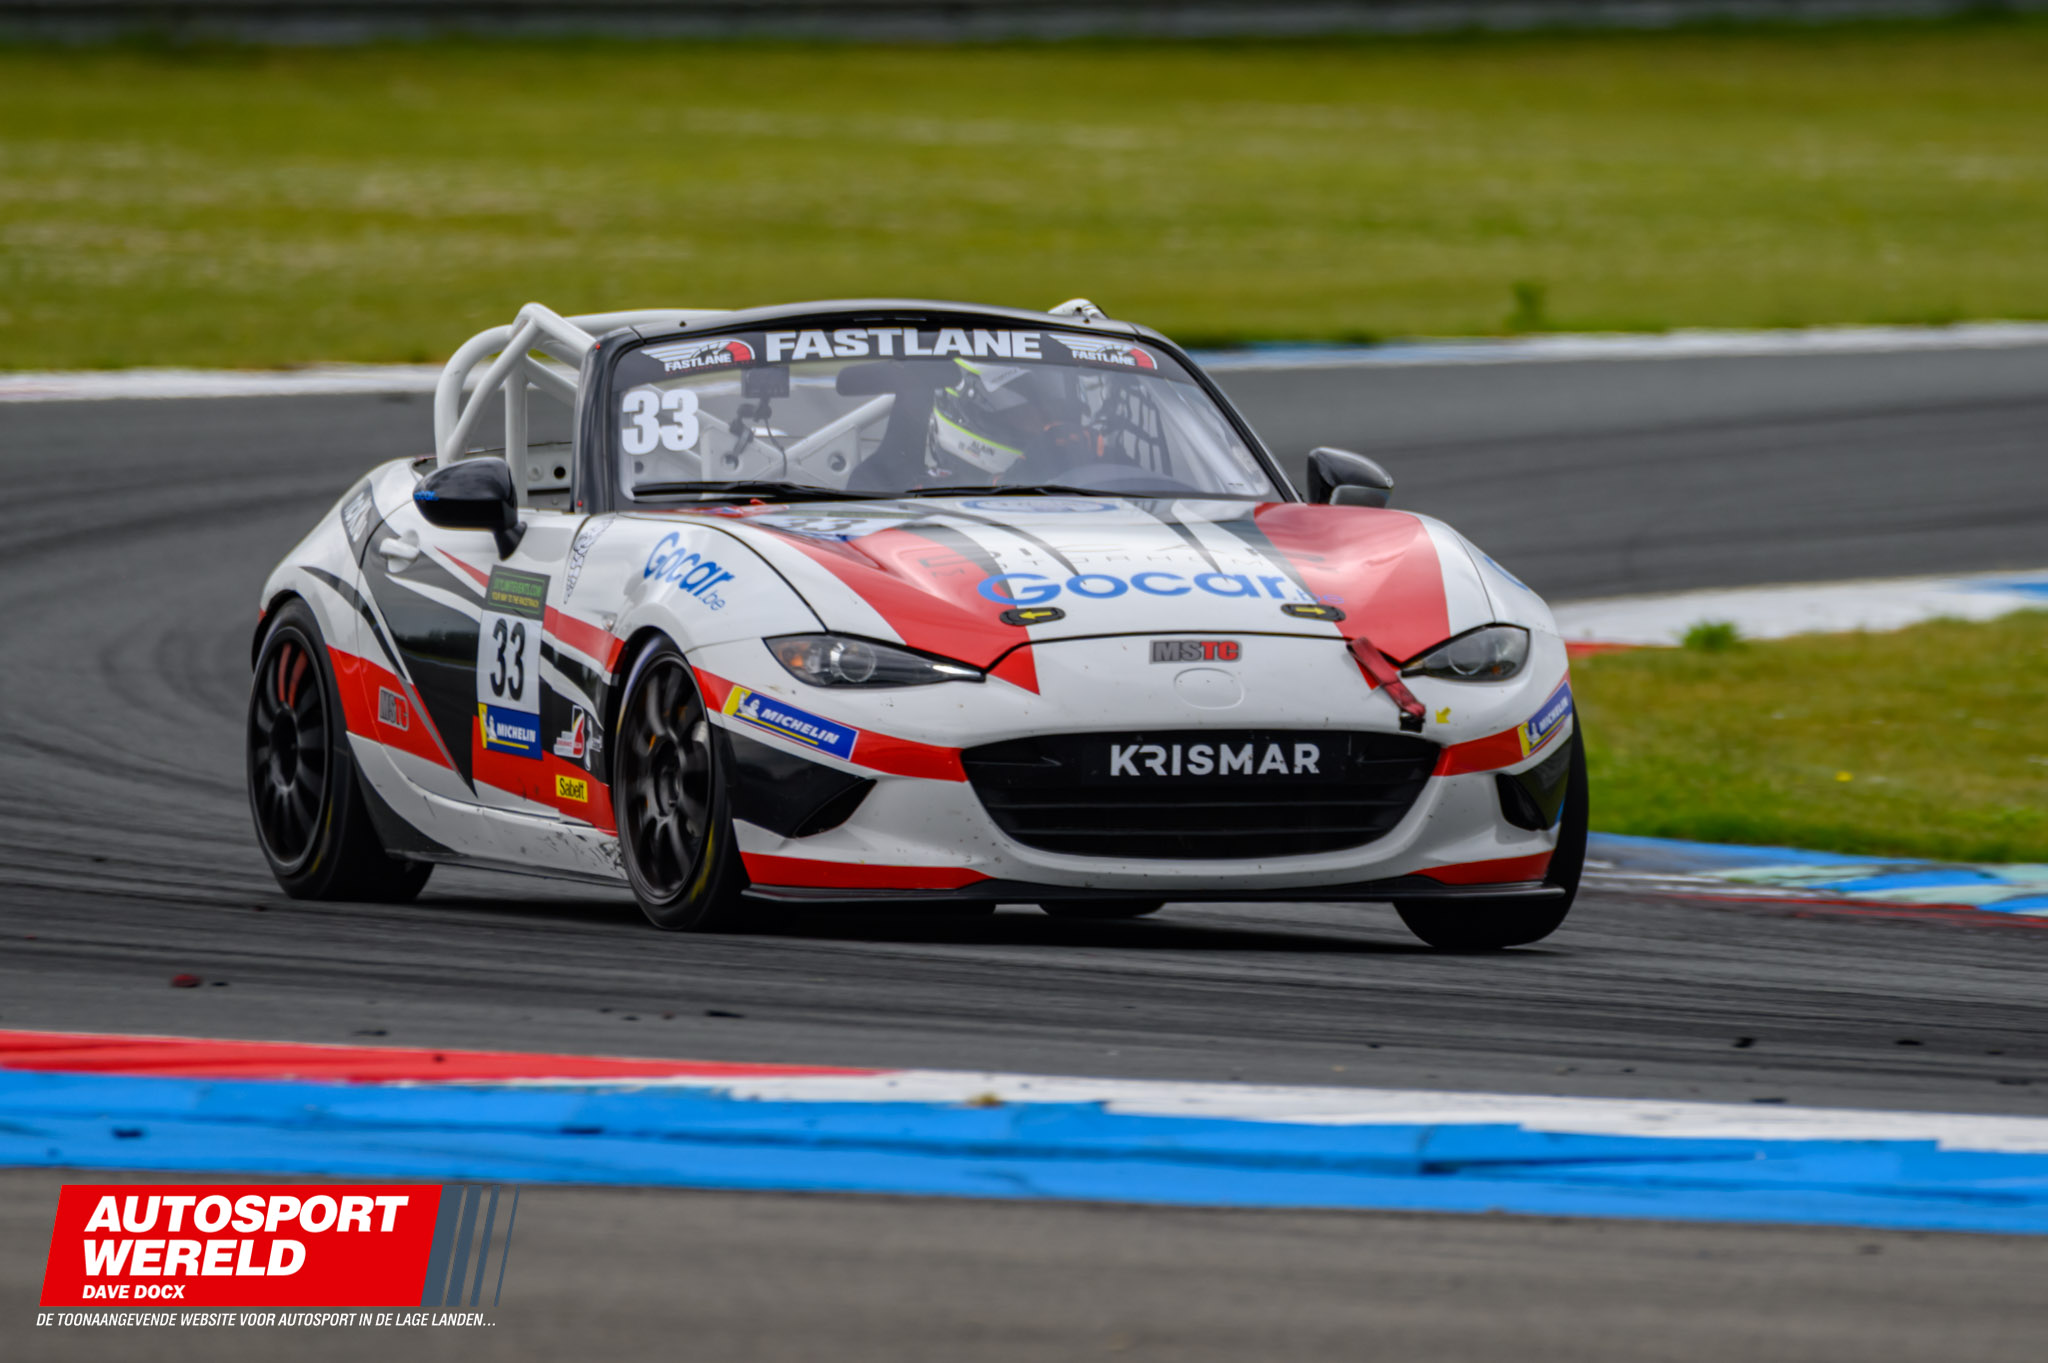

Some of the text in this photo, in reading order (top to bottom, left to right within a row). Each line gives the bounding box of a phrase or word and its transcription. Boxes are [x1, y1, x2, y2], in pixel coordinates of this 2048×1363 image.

[765, 327, 1043, 362] FASTLANE
[1071, 349, 1136, 367] FASTLANE
[663, 352, 732, 373] FASTLANE
[621, 388, 700, 456] 33
[489, 618, 527, 702] 33
[1151, 640, 1239, 663] MSTC
[496, 722, 537, 745] MICHELIN
[760, 708, 841, 745] MICHELIN
[1110, 743, 1321, 777] KRISMAR
[559, 777, 585, 800] Sabelt
